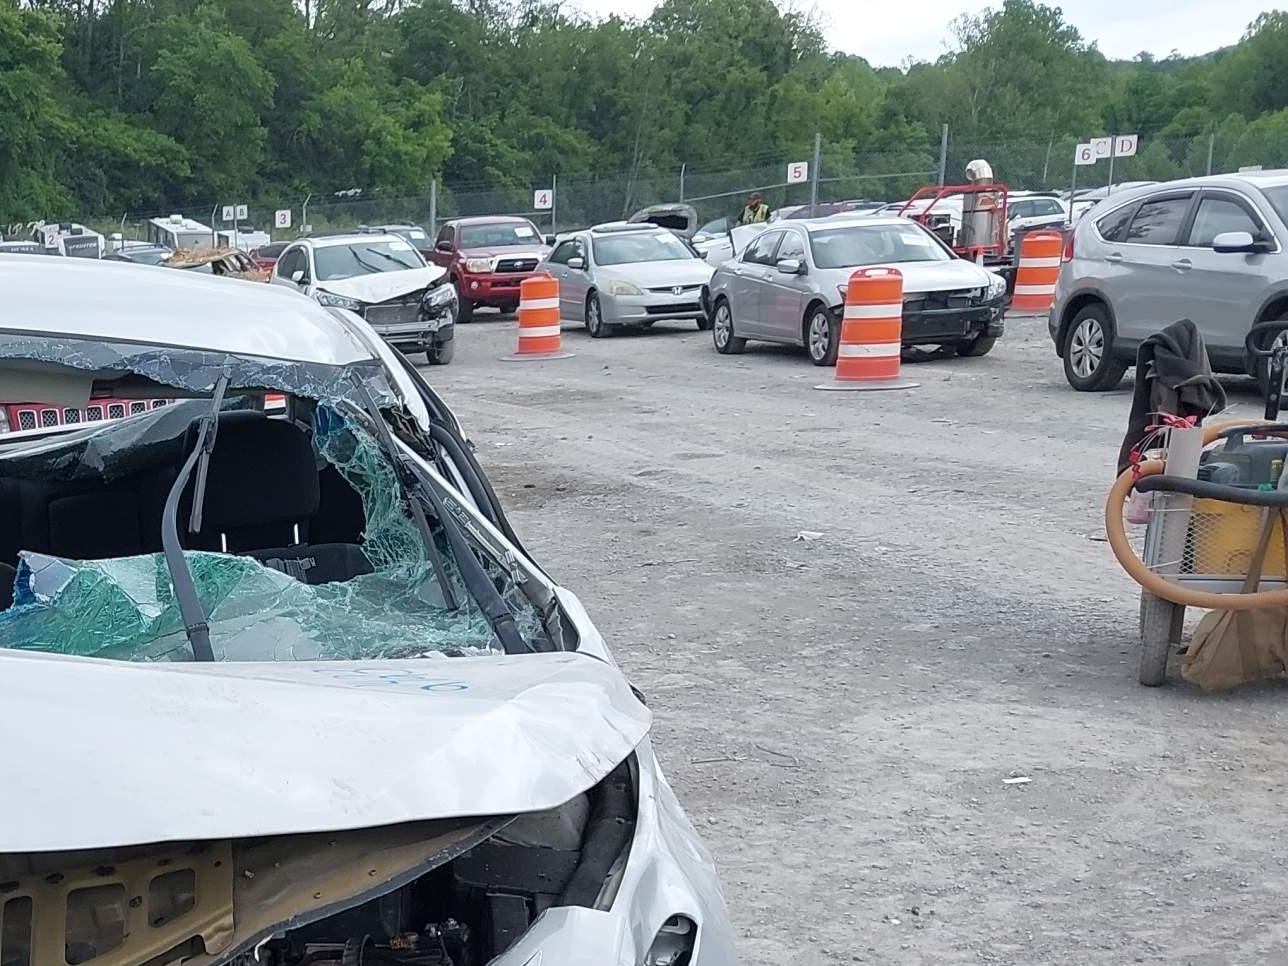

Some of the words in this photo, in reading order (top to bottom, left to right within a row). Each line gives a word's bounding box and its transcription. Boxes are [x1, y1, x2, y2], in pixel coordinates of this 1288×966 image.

[1096, 141, 1107, 154] C
[1120, 139, 1133, 153] D
[1082, 148, 1090, 160] 6
[794, 166, 802, 178] 5
[539, 192, 547, 205] 4
[279, 213, 287, 225] 3
[48, 234, 56, 245] 2
